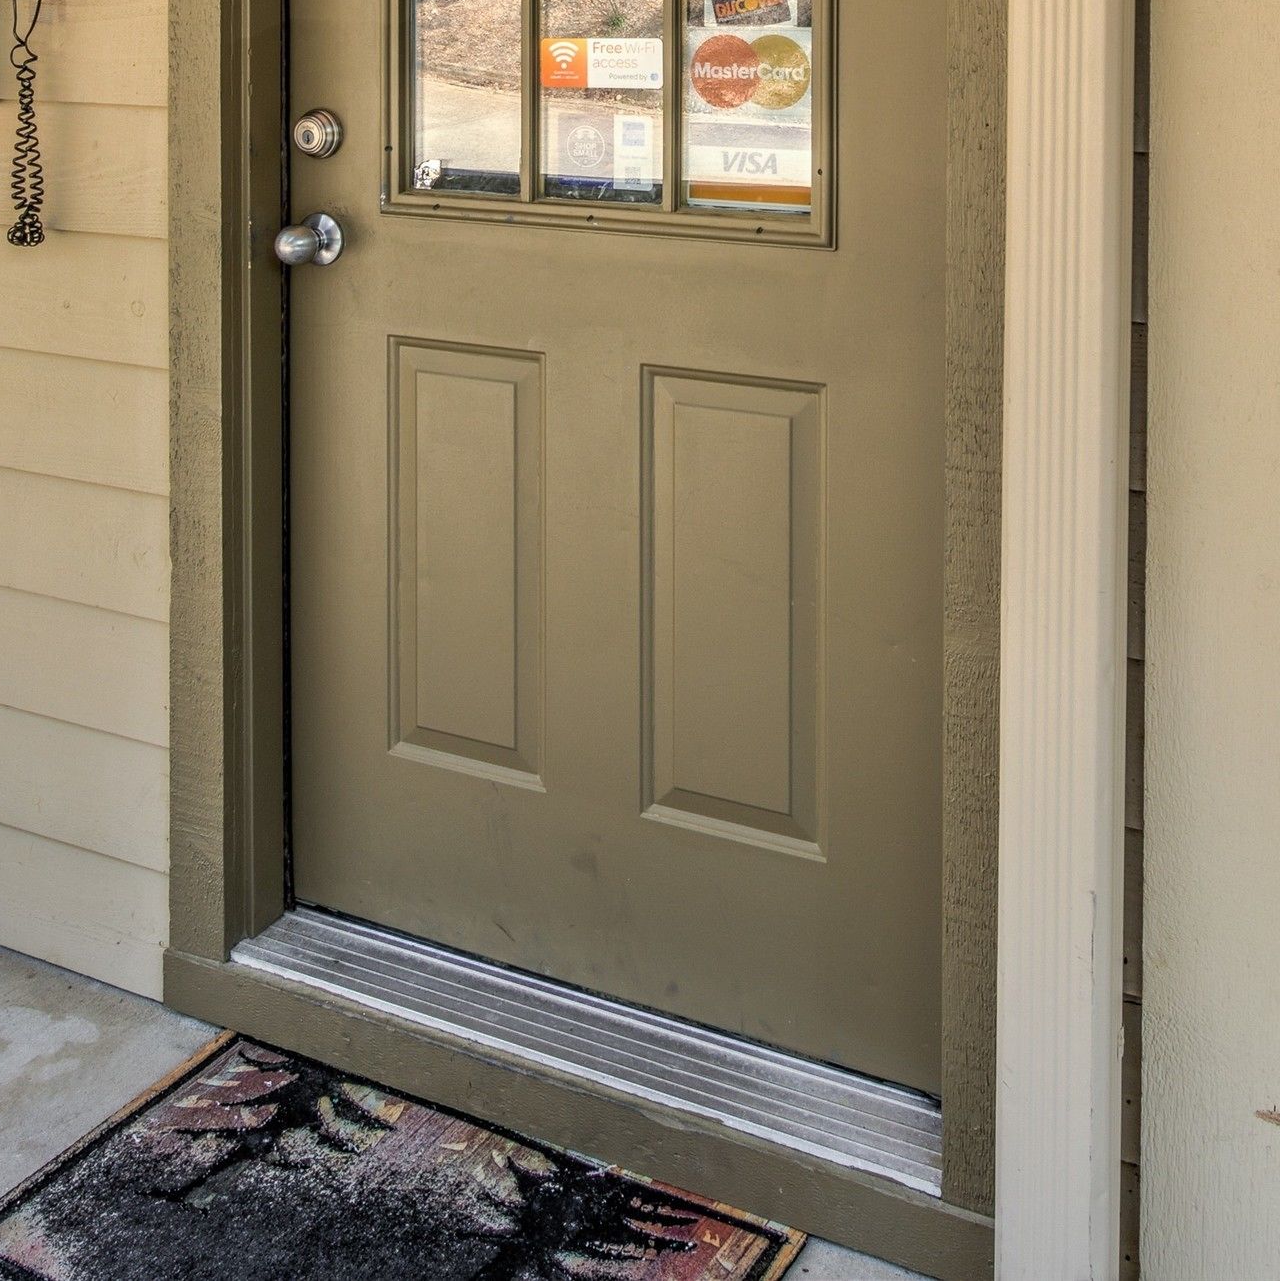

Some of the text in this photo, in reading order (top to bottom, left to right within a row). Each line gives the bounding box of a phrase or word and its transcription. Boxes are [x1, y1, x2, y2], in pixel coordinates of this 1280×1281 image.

[592, 41, 656, 54] Free Wi-Fi
[592, 58, 638, 69] access
[608, 72, 647, 82] Powered by
[694, 61, 805, 80] MasterCard
[721, 150, 778, 174] VISA
